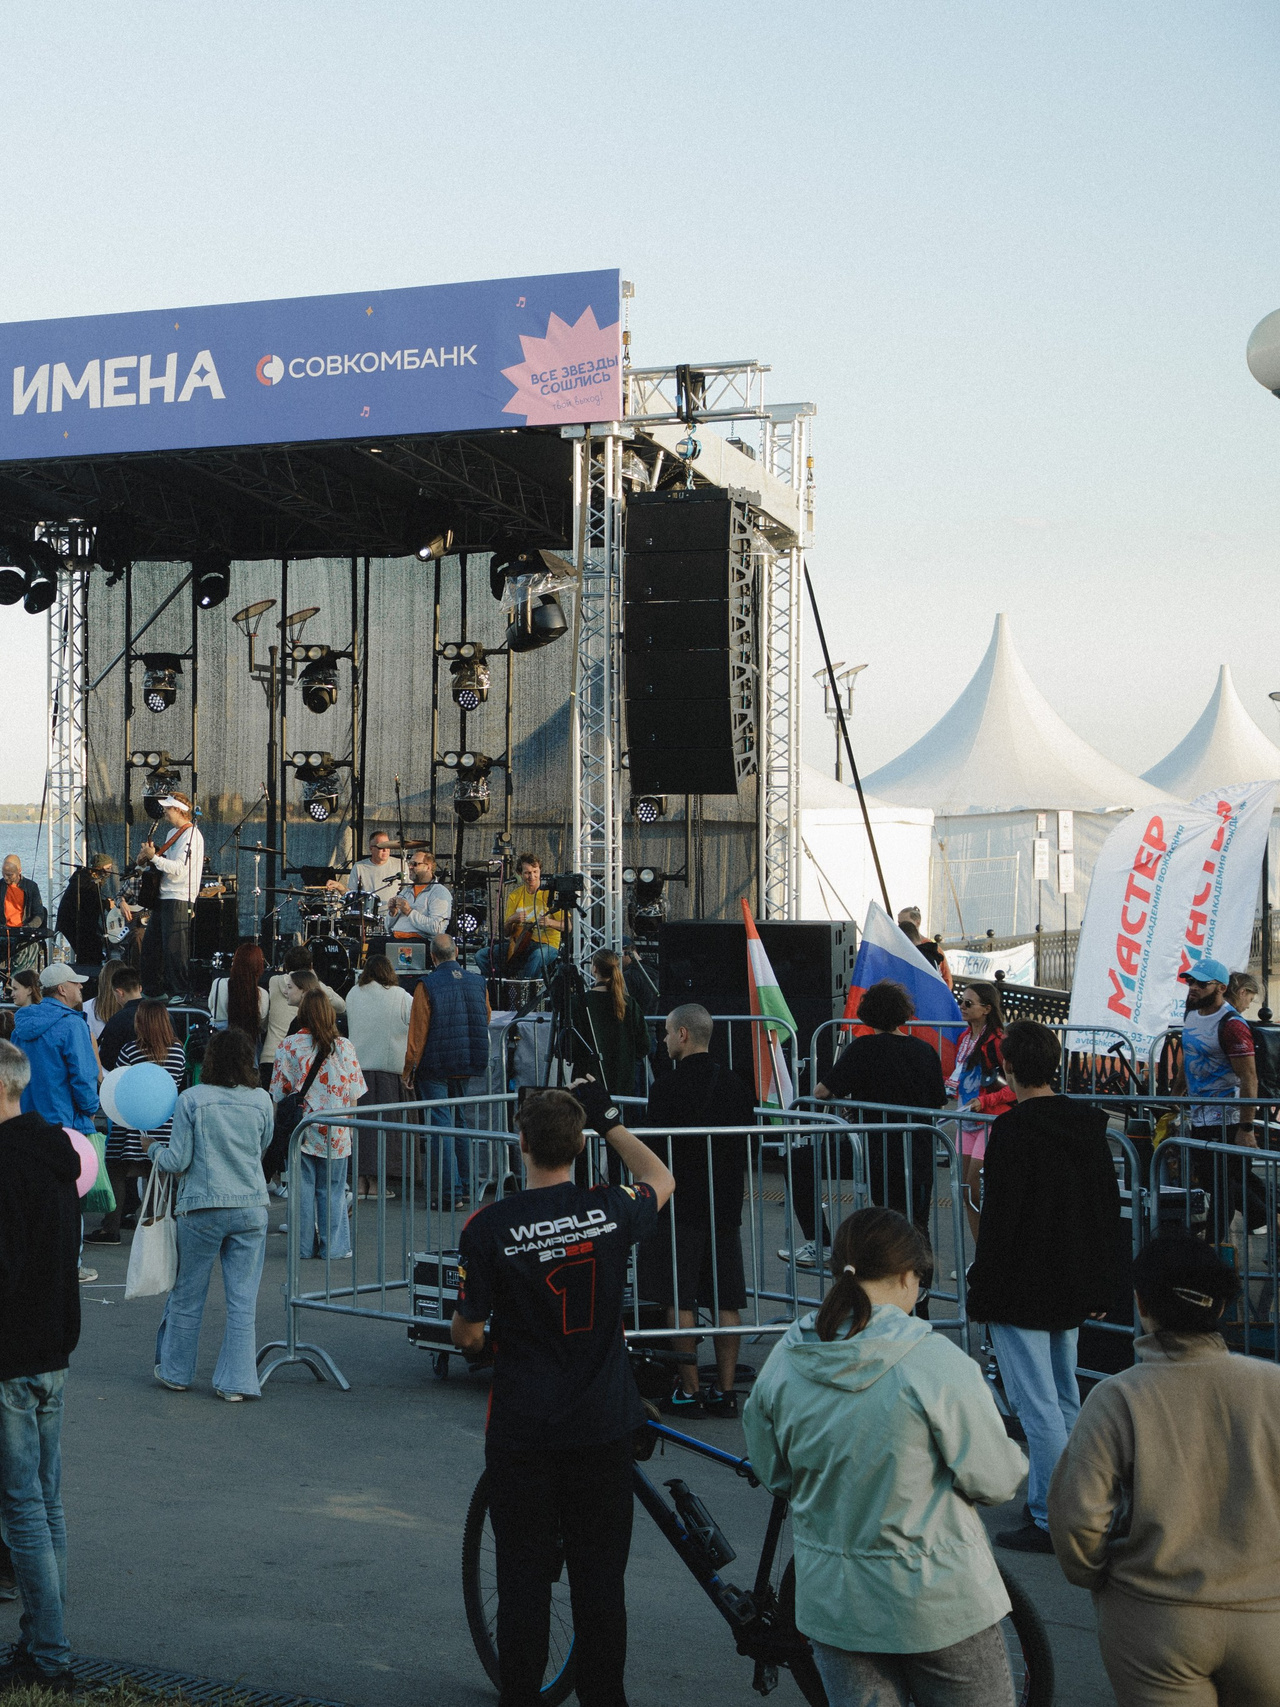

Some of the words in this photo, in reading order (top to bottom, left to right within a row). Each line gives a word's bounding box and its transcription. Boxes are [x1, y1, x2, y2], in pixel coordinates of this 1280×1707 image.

[287, 344, 478, 379] СОВКОМБАНК
[531, 369, 558, 385] ВСЕ
[561, 355, 618, 378] ЗВЕЗДЫ
[13, 349, 226, 415] ИМЕНА
[540, 372, 611, 396] СОШЛИСЬ
[1213, 854, 1227, 917] АКАДЕМИЯ
[1107, 815, 1168, 1020] МАСТЕР
[1133, 948, 1151, 1025] РОССИЙСКАЯ
[1146, 885, 1163, 948] АКАДЕМИЯ
[504, 1222, 618, 1256] CHAMPIONSHIP
[509, 1208, 607, 1242] WORLD
[538, 1241, 594, 1263] 2022
[545, 1257, 596, 1335] 1
